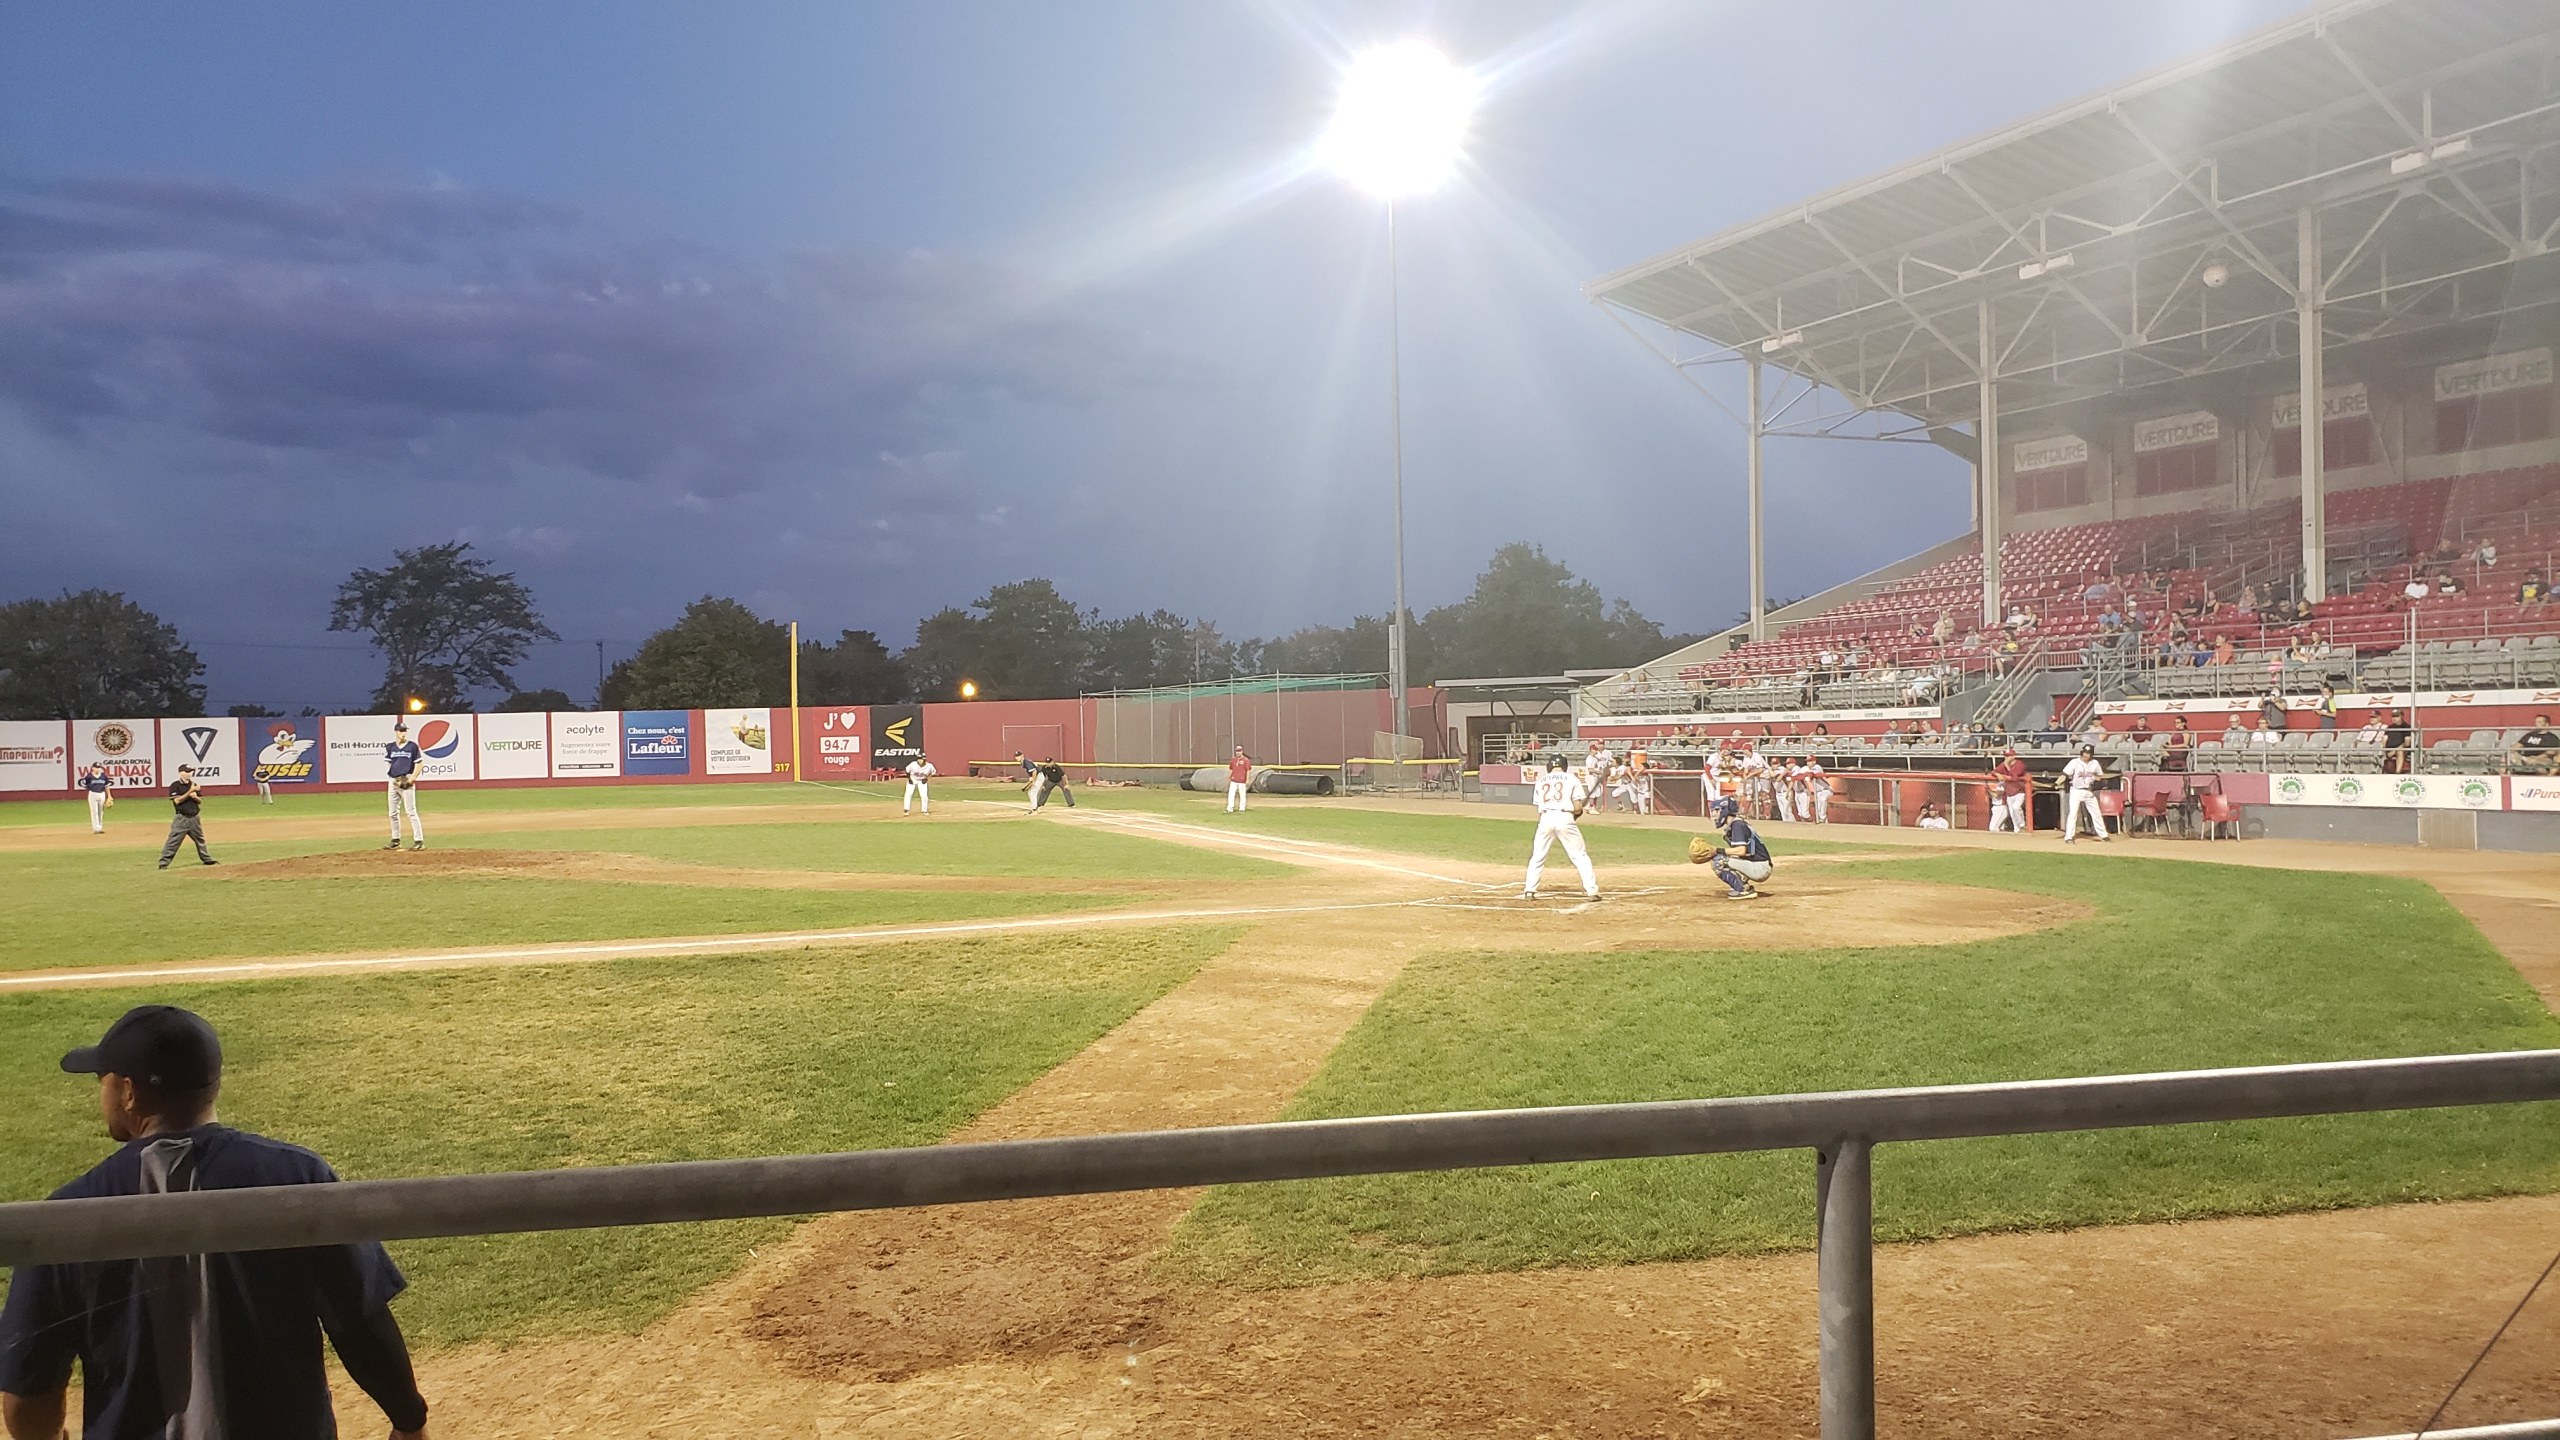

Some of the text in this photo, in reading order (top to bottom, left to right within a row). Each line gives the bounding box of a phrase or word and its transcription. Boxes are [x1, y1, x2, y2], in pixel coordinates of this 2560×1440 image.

[2275, 393, 2366, 425] VEDURE
[2137, 423, 2216, 449] VERTDURE
[2017, 444, 2085, 467] VERTDURE
[566, 725, 605, 736] acolyte
[352, 740, 387, 748] Horizo
[484, 741, 542, 751] VERTDURE
[631, 742, 683, 754] Lafleur
[824, 739, 849, 751] 94.7
[875, 748, 920, 757] EASTON
[824, 756, 849, 766] rouge
[78, 765, 152, 777] WLINAK
[192, 767, 220, 777] IZZA
[421, 762, 456, 775] pepsi
[774, 763, 790, 772] 317
[78, 777, 152, 787] CSINO
[1541, 782, 1564, 803] 23
